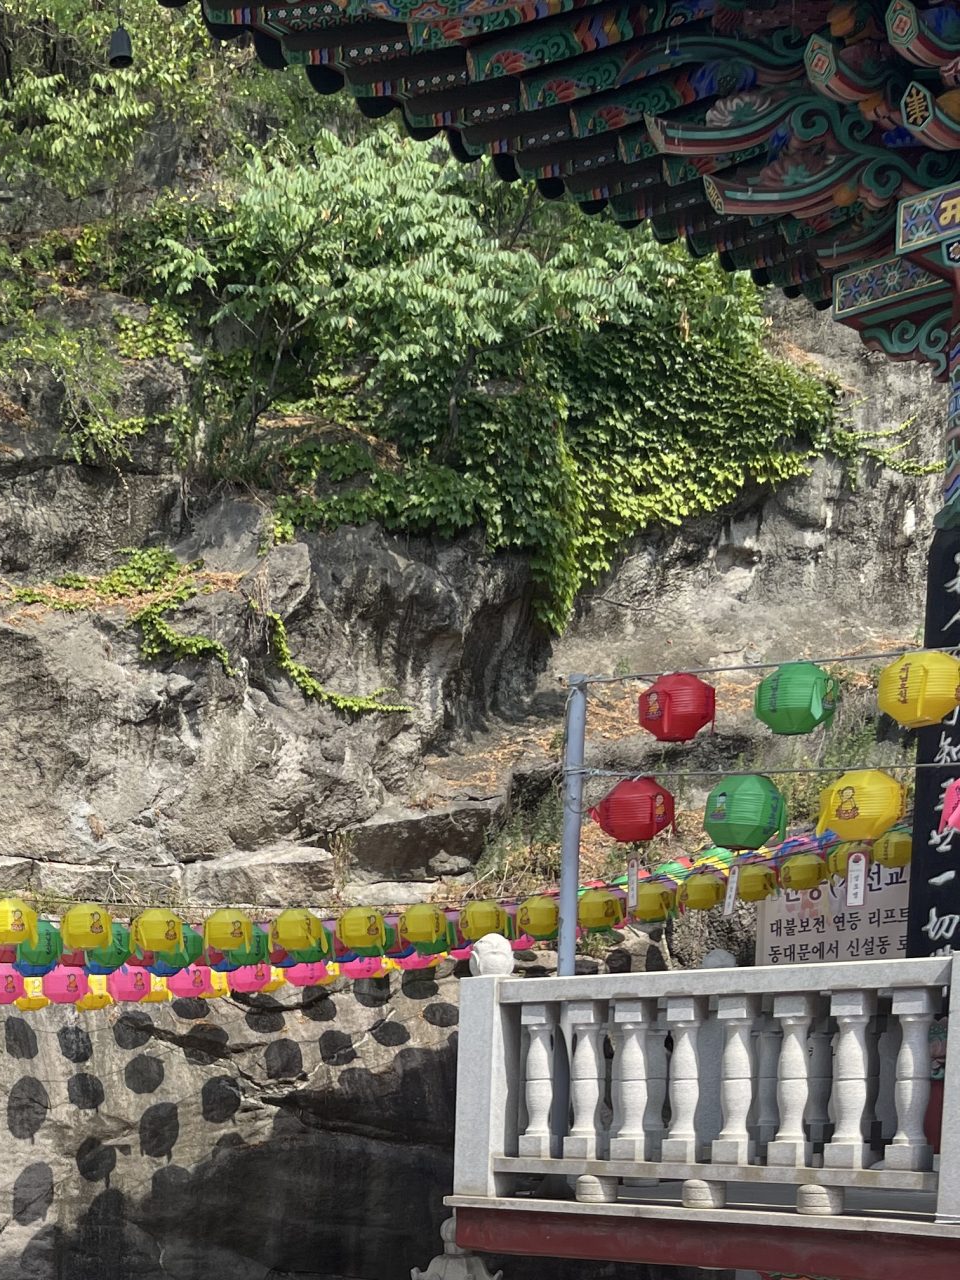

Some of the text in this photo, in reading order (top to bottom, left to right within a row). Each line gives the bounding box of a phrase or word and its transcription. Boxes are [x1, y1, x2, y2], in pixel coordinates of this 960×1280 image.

[770, 914, 825, 937] 대불보전
[833, 912, 862, 931] 연등
[768, 940, 839, 963] 동대문에서
[847, 936, 891, 957] 신설동
